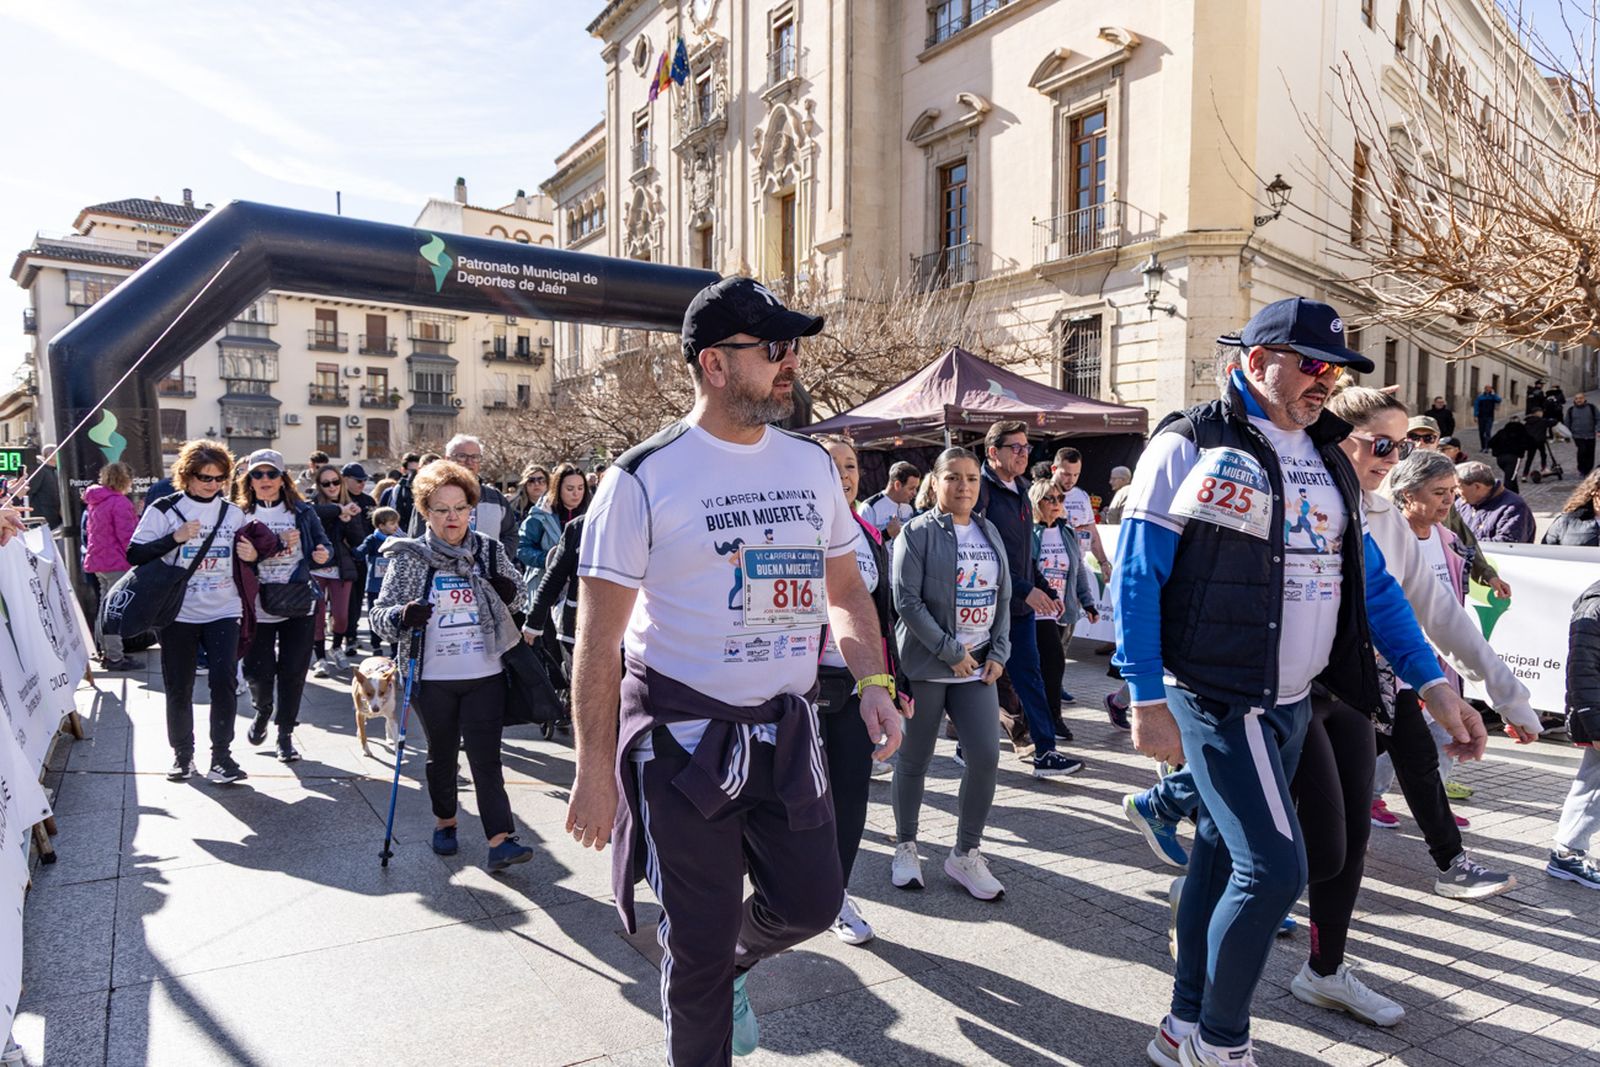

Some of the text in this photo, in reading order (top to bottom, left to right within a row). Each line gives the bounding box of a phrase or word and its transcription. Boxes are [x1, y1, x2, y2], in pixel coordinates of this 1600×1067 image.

[457, 256, 598, 285] Patronato Municipal de
[457, 271, 567, 295] Deportes de Jaén
[1222, 465, 1254, 484] MUERTE
[1287, 471, 1330, 486] MUERTE
[701, 489, 817, 509] VI CARRERA CAMINATA
[1196, 477, 1254, 513] 825
[705, 505, 805, 532] BUENA MUERTE
[764, 551, 797, 560] CARRERA
[756, 562, 812, 576] BUENA MUERTE
[773, 578, 813, 609] 816
[960, 607, 988, 624] 905
[1497, 653, 1561, 670] nicipal de
